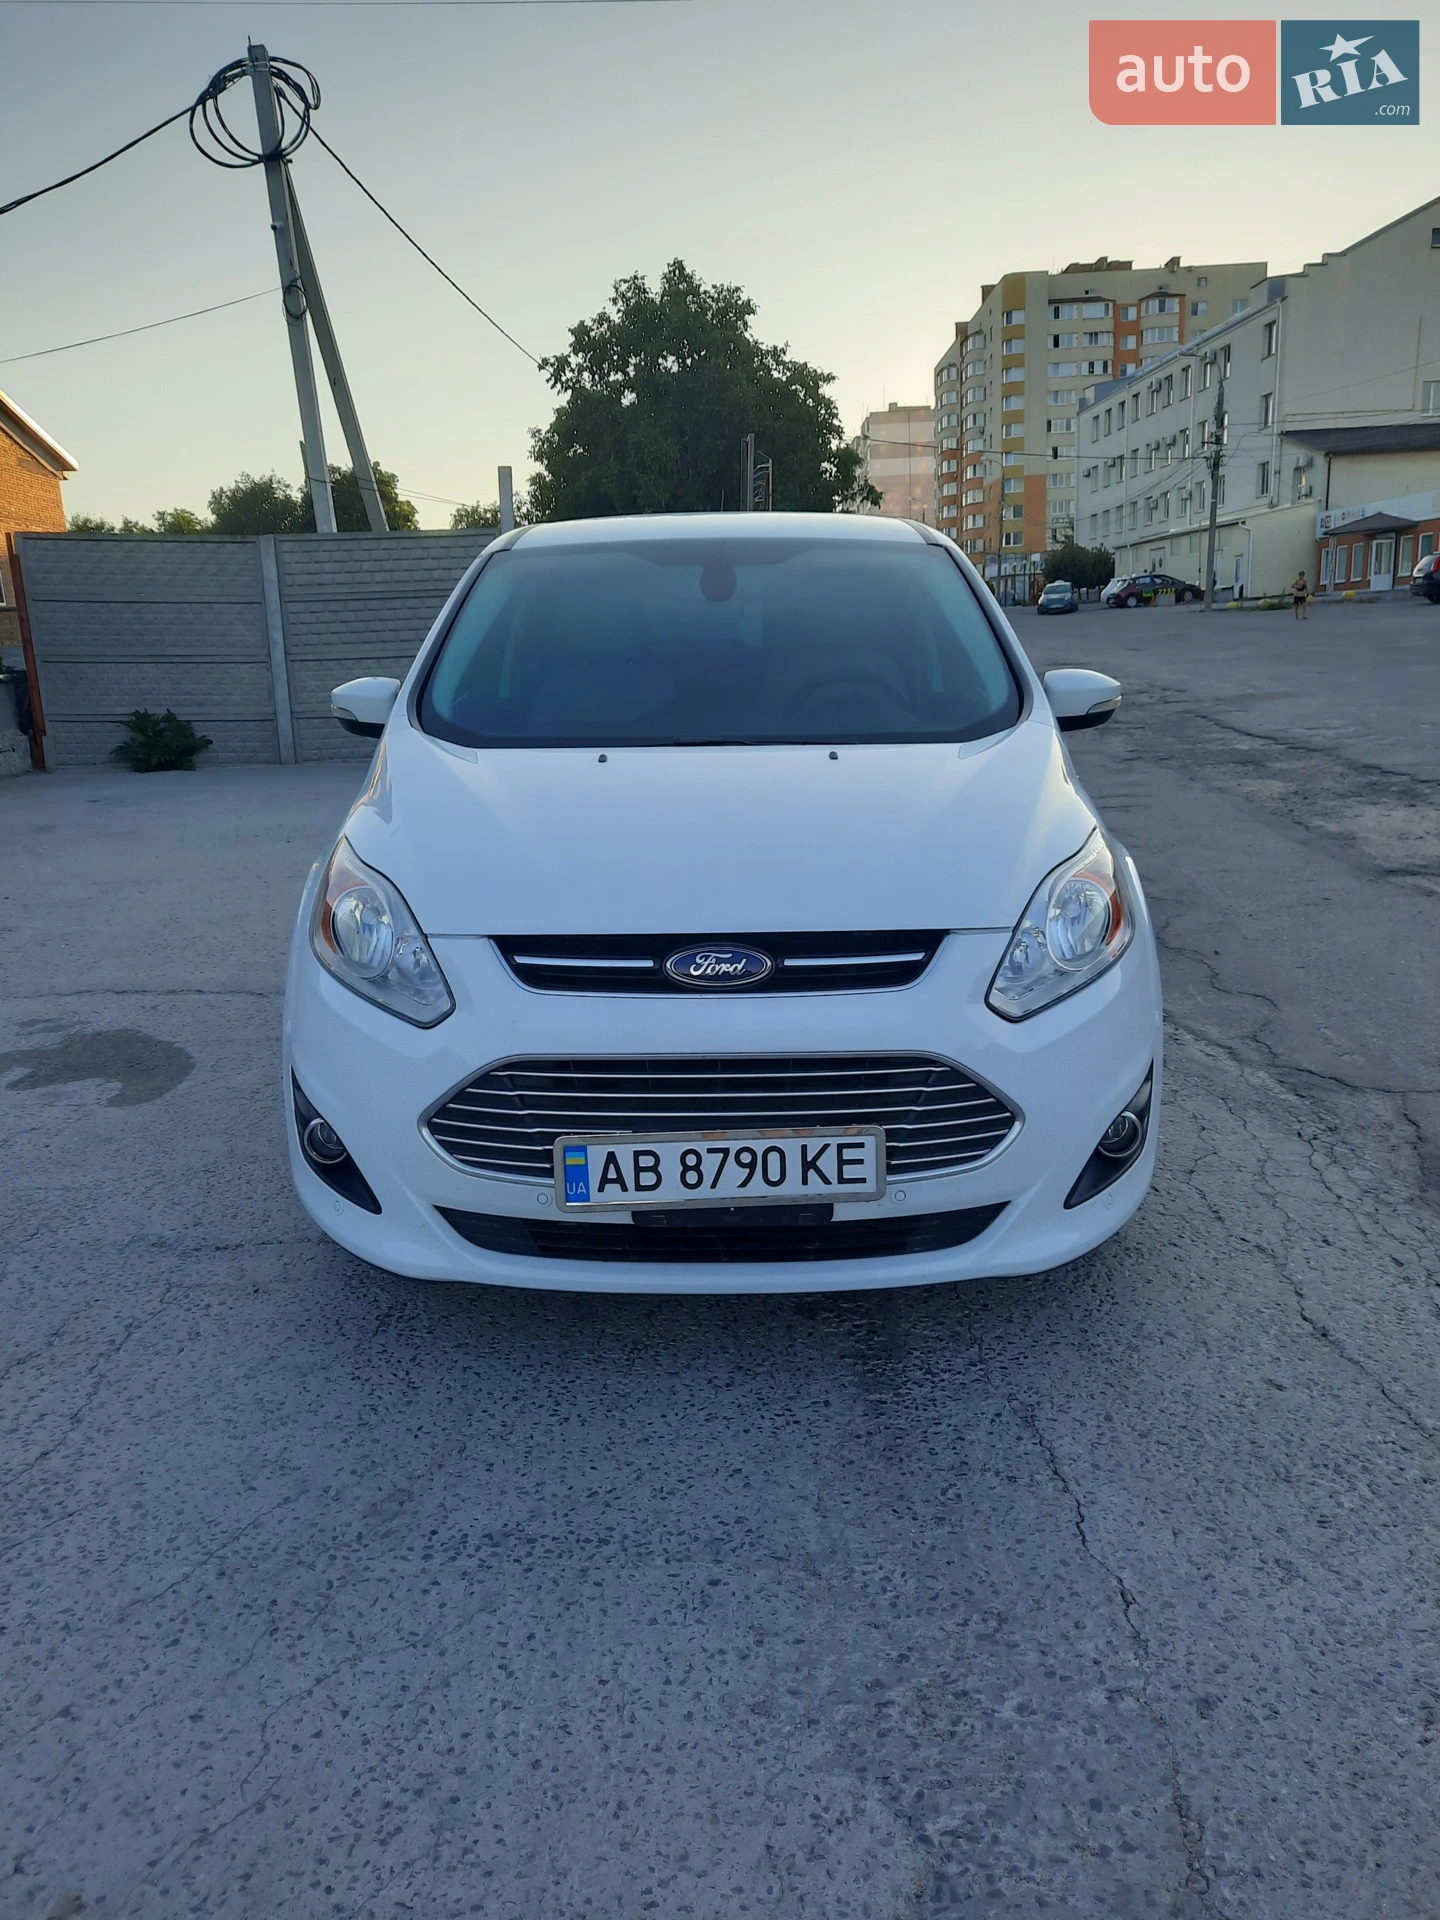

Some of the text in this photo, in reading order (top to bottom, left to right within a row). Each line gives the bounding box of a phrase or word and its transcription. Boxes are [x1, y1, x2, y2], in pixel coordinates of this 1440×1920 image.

[689, 952, 747, 976] Ford
[597, 1141, 867, 1193] AB 8790 KE
[566, 1181, 587, 1195] UA
